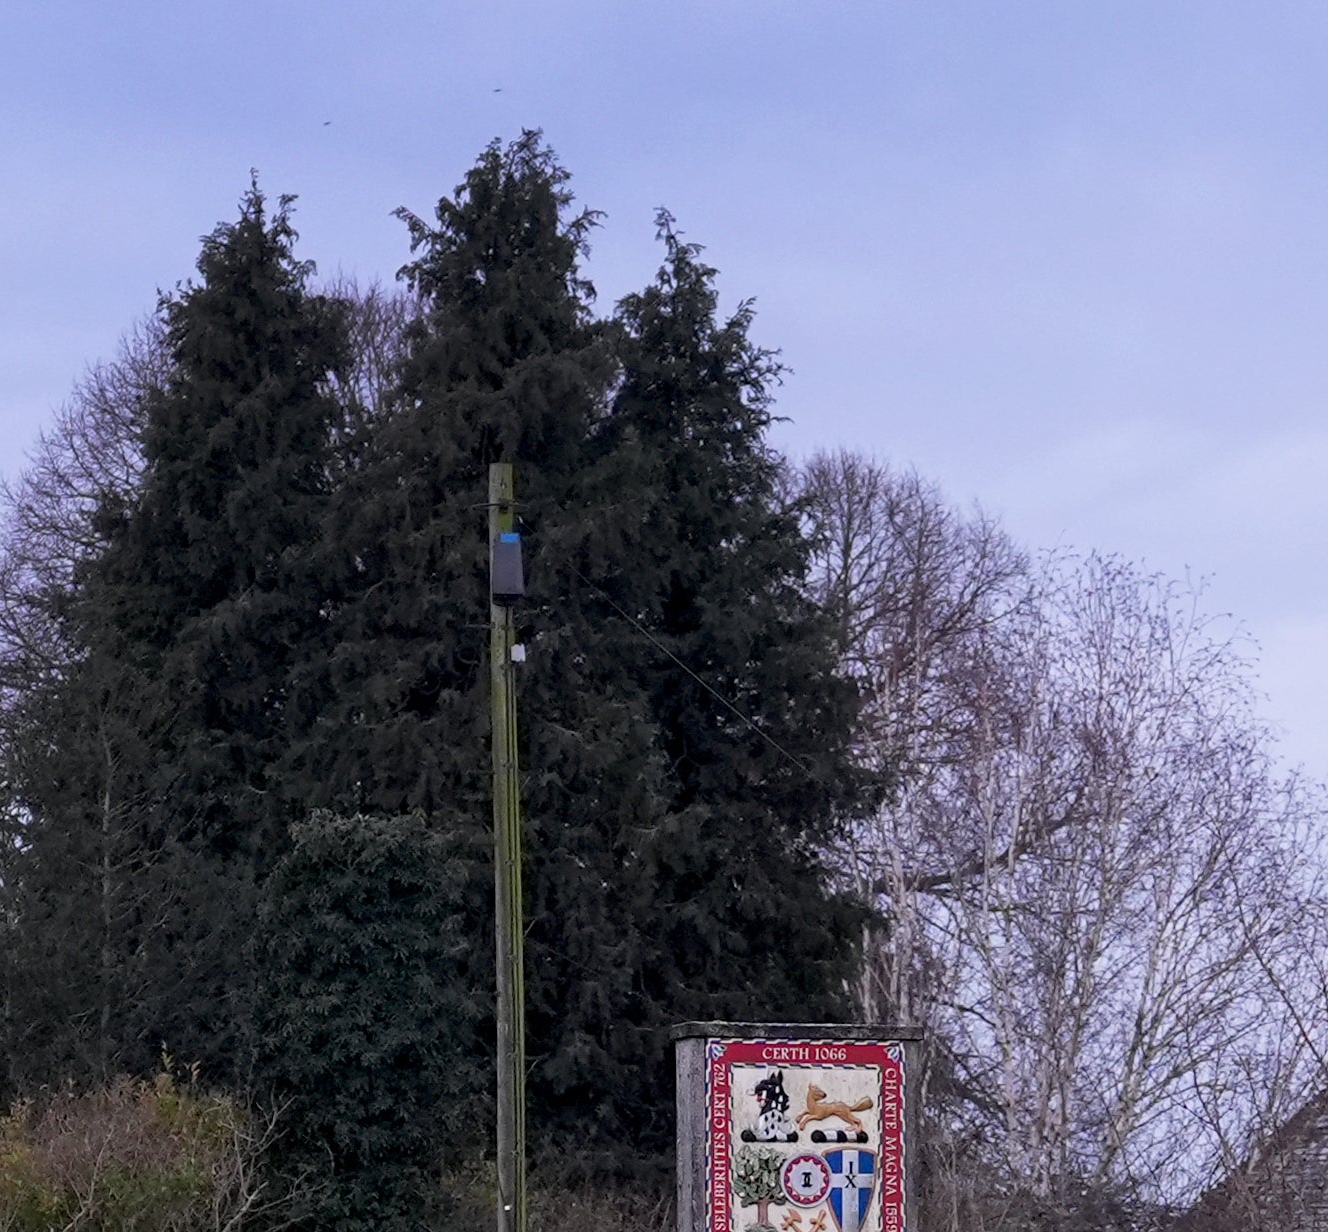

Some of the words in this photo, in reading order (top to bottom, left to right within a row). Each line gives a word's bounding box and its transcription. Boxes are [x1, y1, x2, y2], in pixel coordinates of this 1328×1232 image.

[714, 1063, 726, 1088] 762
[762, 1047, 809, 1060] CERTH
[815, 1047, 847, 1061] 1066
[713, 1092, 726, 1129] CERT
[884, 1067, 897, 1130] CHARTE
[714, 1132, 726, 1232] SELEBERHTES
[884, 1136, 898, 1196] MAGNA
